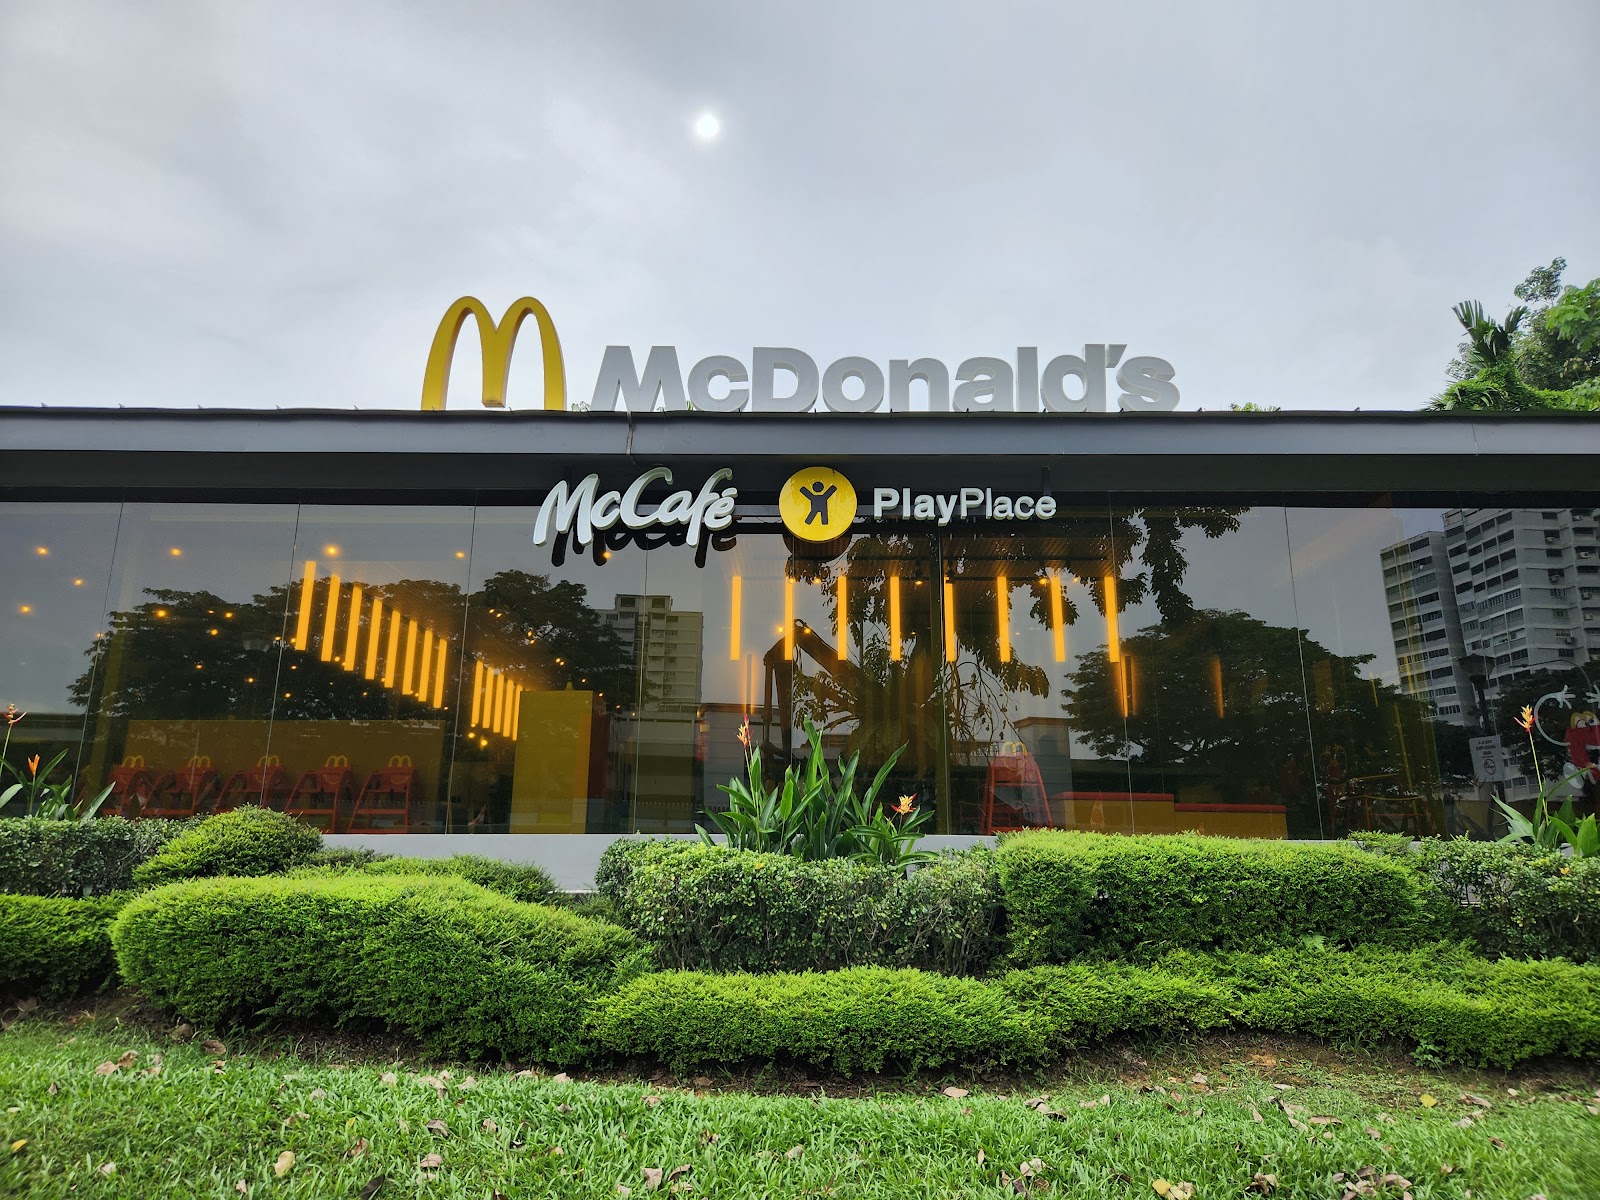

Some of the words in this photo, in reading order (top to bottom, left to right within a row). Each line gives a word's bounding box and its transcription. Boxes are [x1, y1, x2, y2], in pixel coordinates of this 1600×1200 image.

[591, 343, 1180, 413] McDonald's
[533, 467, 738, 547] McCafé
[874, 488, 1056, 527] PlayPlace
